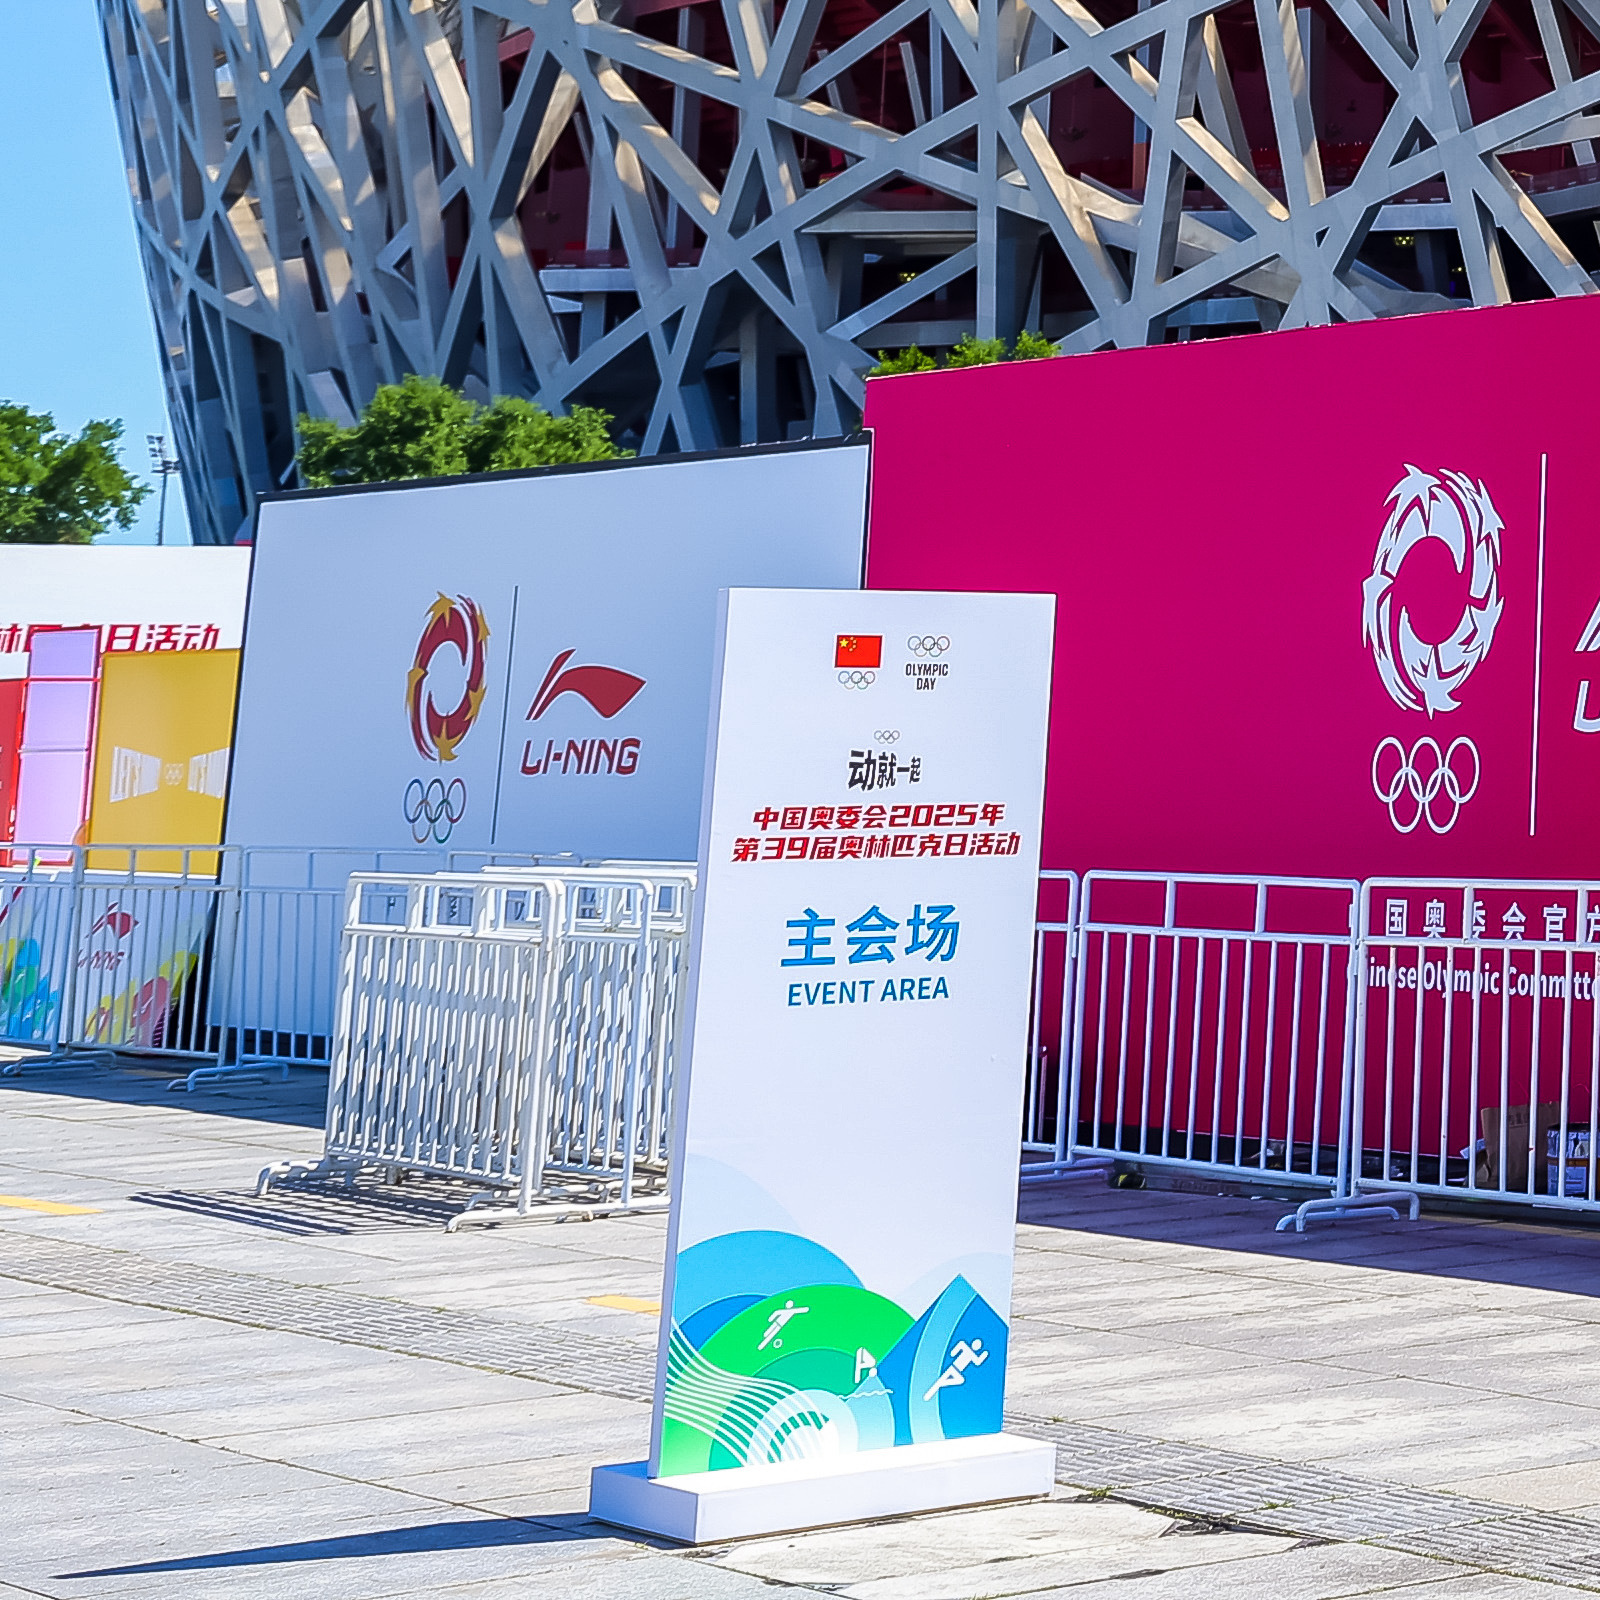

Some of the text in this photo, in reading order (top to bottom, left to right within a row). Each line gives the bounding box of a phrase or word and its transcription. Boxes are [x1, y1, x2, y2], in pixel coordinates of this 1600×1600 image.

[0, 622, 221, 653] 林日活动
[905, 662, 949, 678] OLYMPIC
[916, 677, 937, 691] DAY
[519, 736, 642, 776] LI-NING
[848, 749, 922, 791] 动就一起
[752, 803, 1006, 831] 中国奥委会2025年
[730, 831, 1021, 862] 第39届奥林匹克日活动
[779, 903, 961, 968] 主会场
[787, 976, 949, 1007] EVENT AREA
